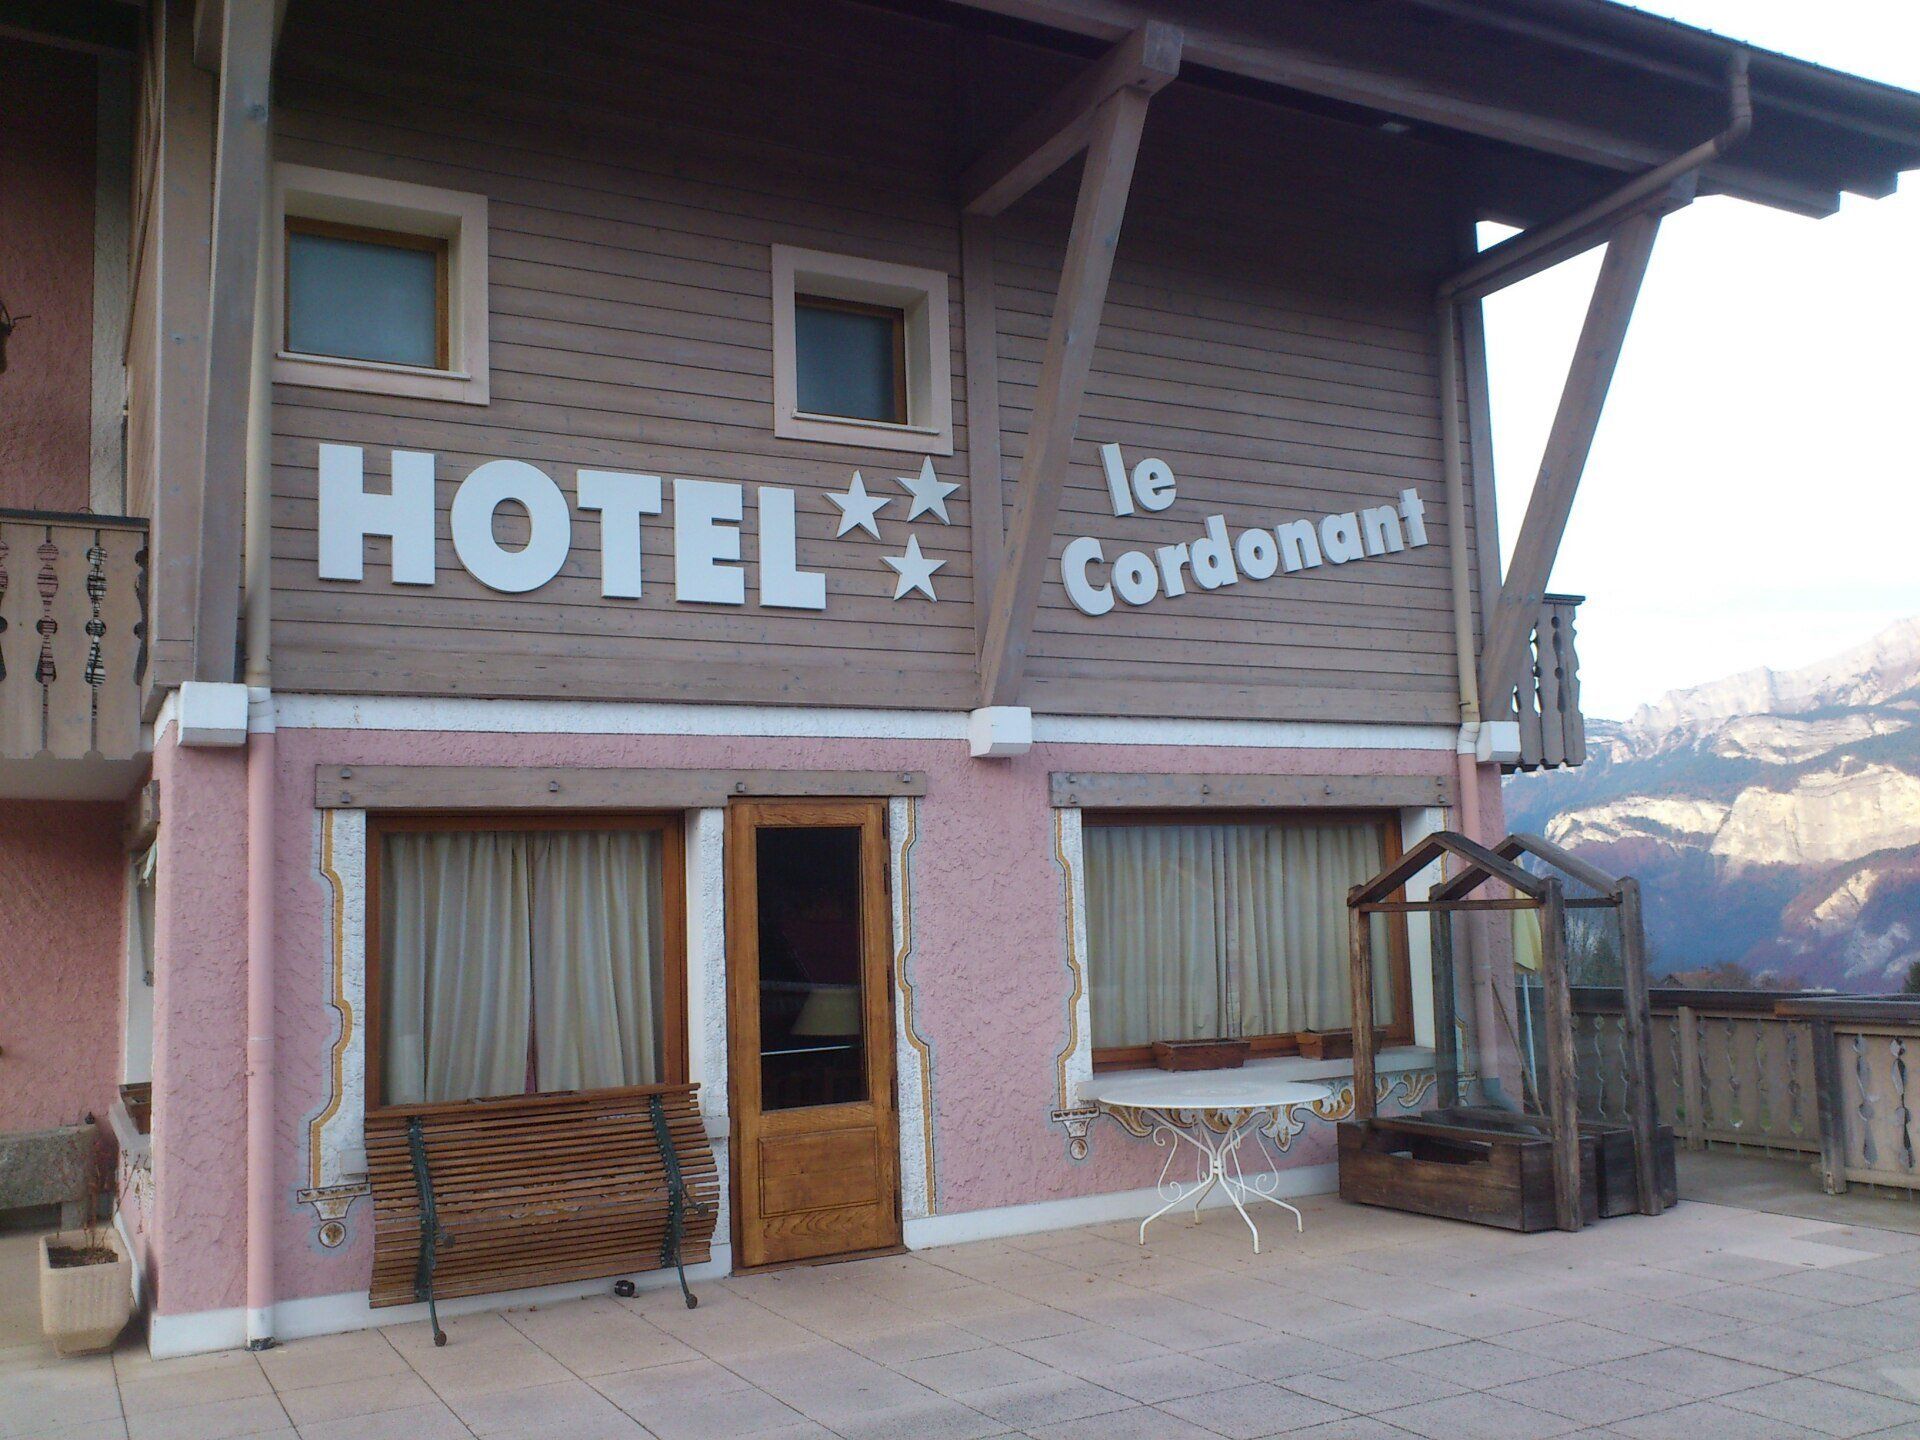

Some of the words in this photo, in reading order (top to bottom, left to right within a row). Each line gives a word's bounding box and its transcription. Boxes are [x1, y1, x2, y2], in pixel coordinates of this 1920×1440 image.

[318, 443, 827, 610] HOTEL
[1101, 442, 1177, 517] le
[1060, 487, 1429, 616] Cordonant
